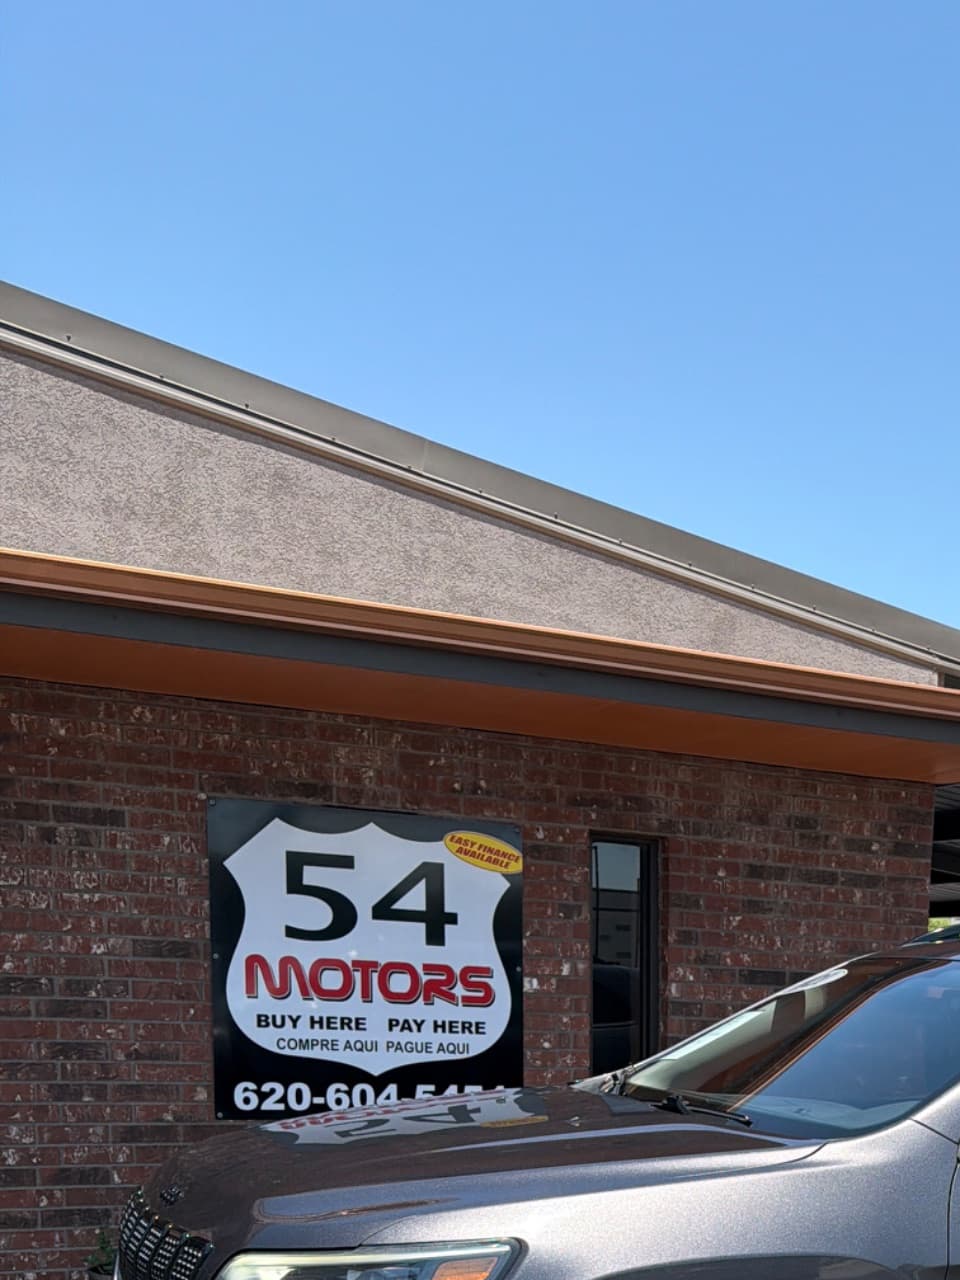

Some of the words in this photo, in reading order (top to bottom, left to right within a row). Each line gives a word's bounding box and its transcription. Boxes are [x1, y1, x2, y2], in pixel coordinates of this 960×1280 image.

[449, 834, 477, 848] EASY
[476, 843, 520, 863] FINANCE
[455, 846, 511, 869] AVAILABLE
[284, 850, 459, 947] 54
[244, 953, 495, 1007] MOTORS
[256, 1013, 302, 1030] BUY
[309, 1015, 368, 1032] HERE
[388, 1018, 426, 1033] PAY
[432, 1019, 487, 1035] HERE
[276, 1037, 339, 1052] COMPRE
[343, 1039, 378, 1054] AQUI
[386, 1040, 433, 1054] PAGUE
[436, 1042, 470, 1056] AQUI
